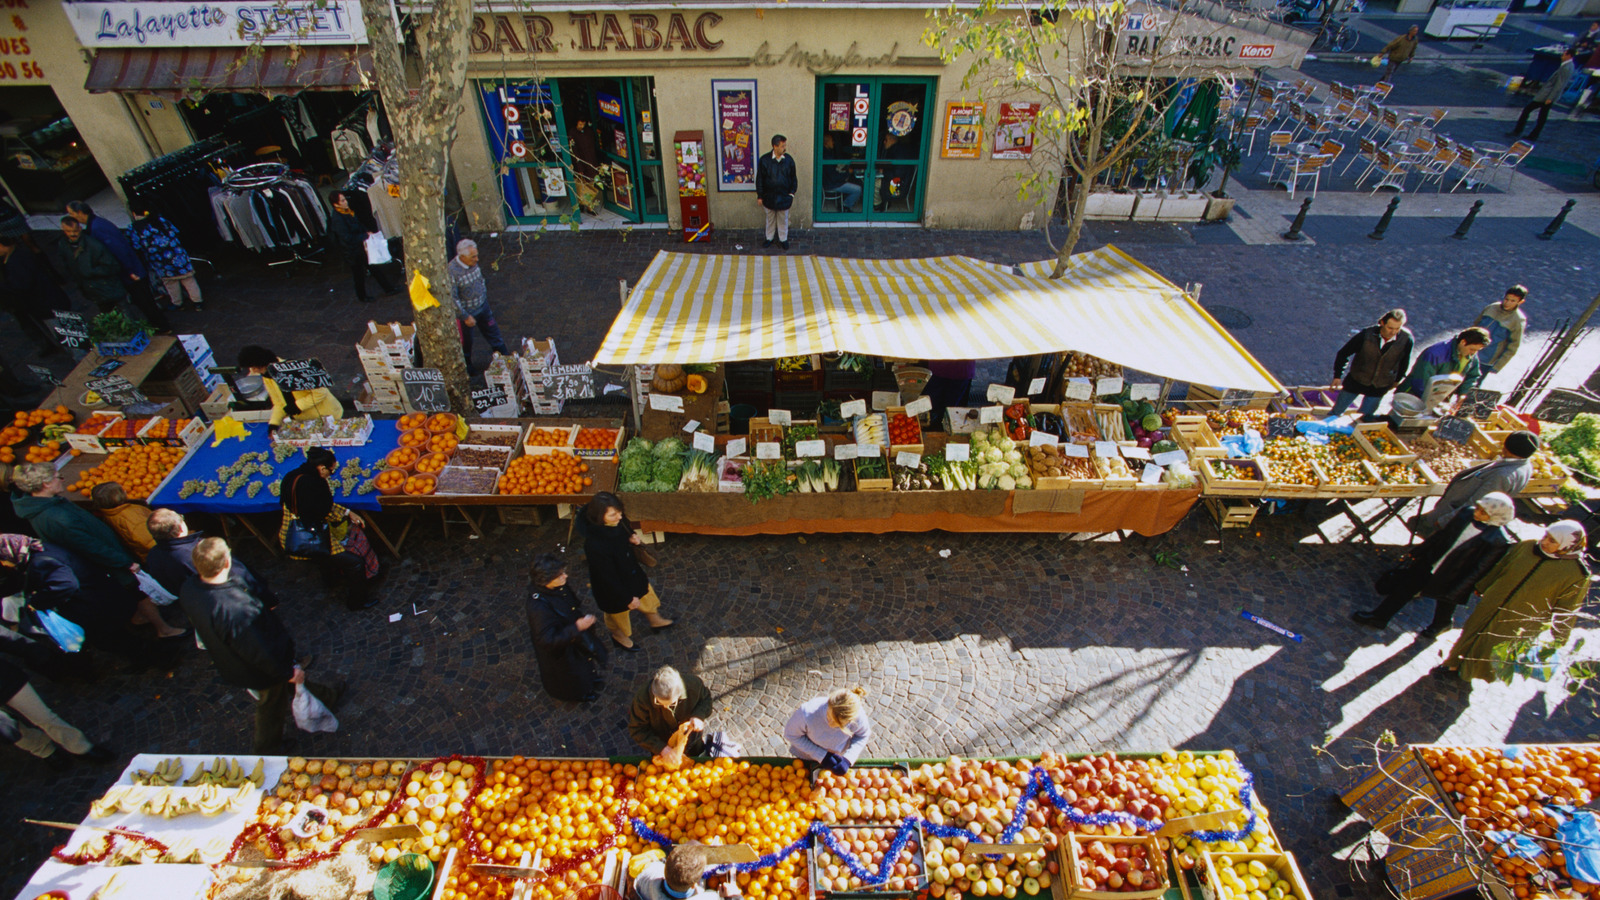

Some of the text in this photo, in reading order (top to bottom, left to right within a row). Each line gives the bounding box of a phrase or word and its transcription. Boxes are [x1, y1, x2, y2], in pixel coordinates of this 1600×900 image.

[96, 6, 347, 45] Lafayette STREET
[470, 12, 725, 53] BAR TABAC
[21, 60, 44, 79] 56
[1242, 45, 1272, 57] Keno
[499, 87, 527, 158] LOTO
[852, 84, 869, 144] LOTO
[404, 370, 445, 381] ORANGE
